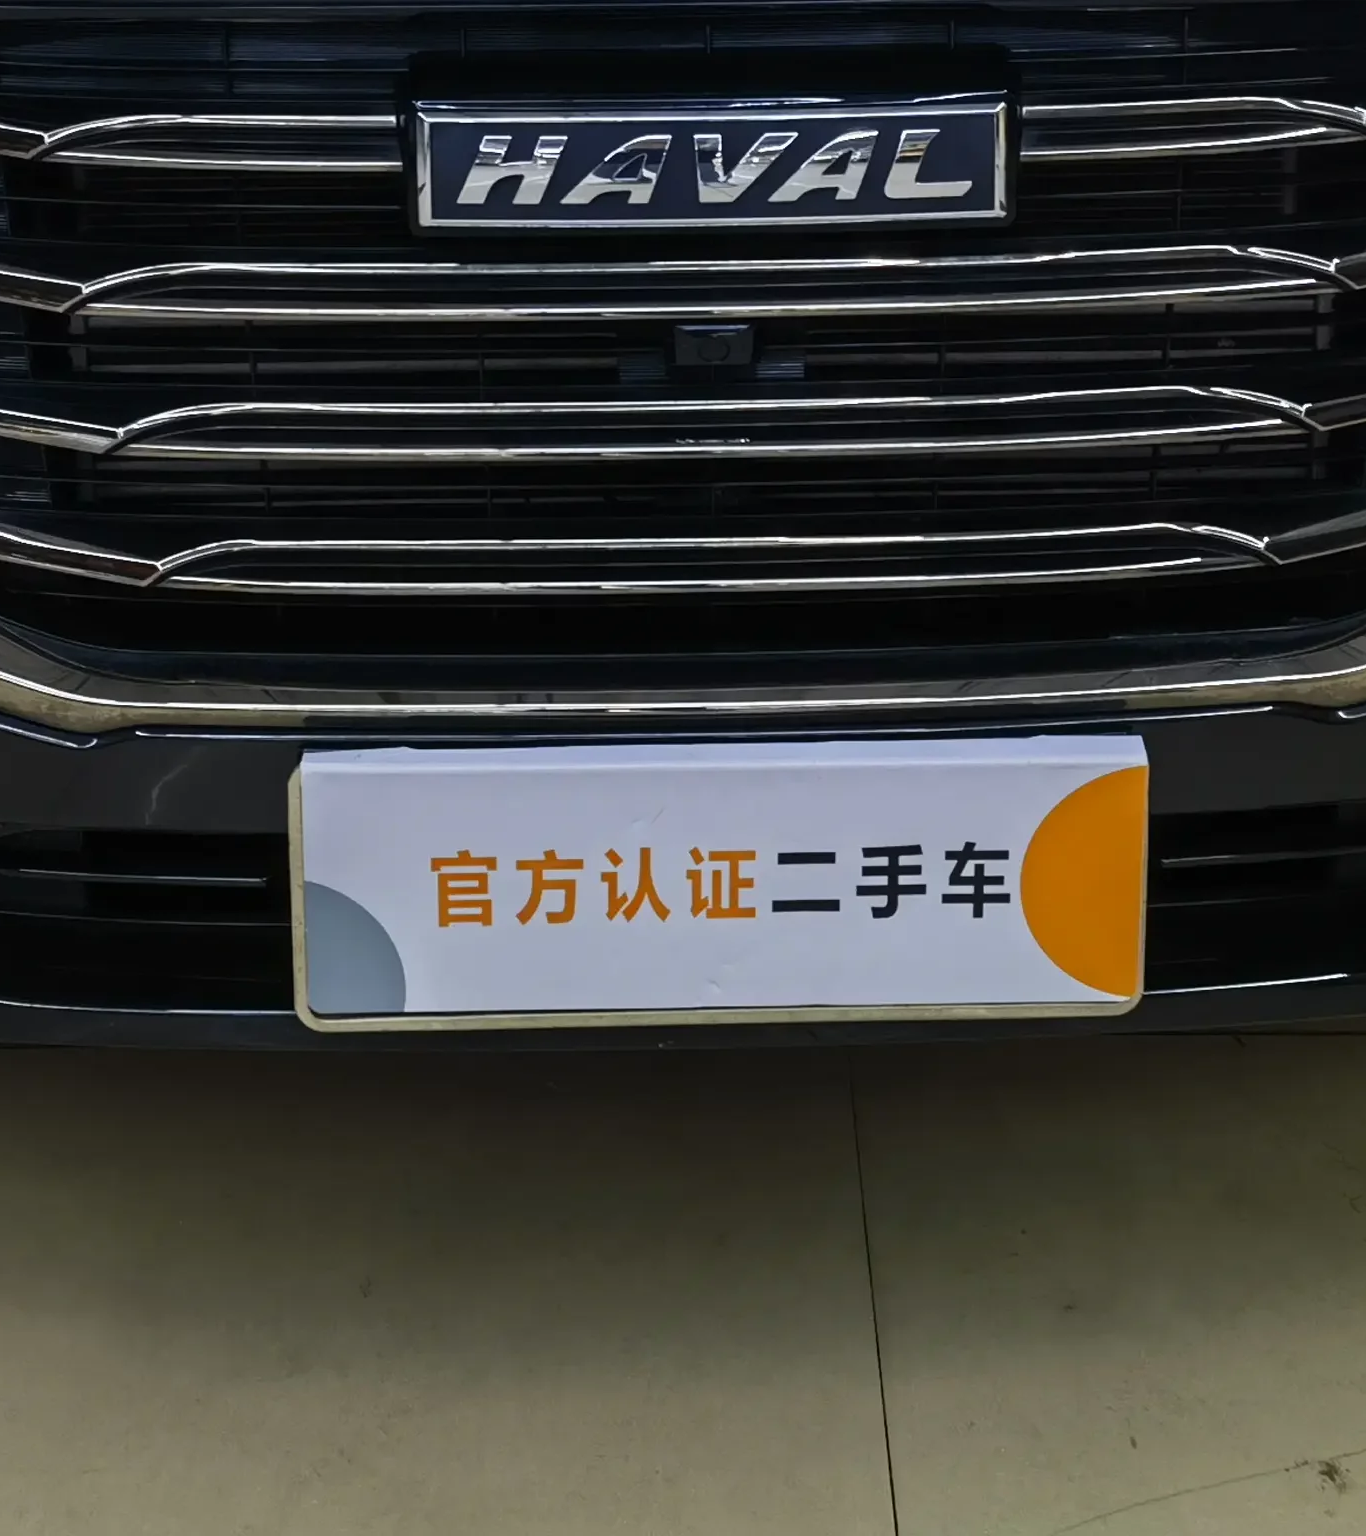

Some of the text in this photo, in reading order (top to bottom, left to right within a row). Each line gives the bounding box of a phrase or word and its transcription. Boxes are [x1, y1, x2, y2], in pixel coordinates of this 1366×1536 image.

[456, 129, 973, 206] HAVAL
[430, 842, 1011, 928] 官方认证二手车
